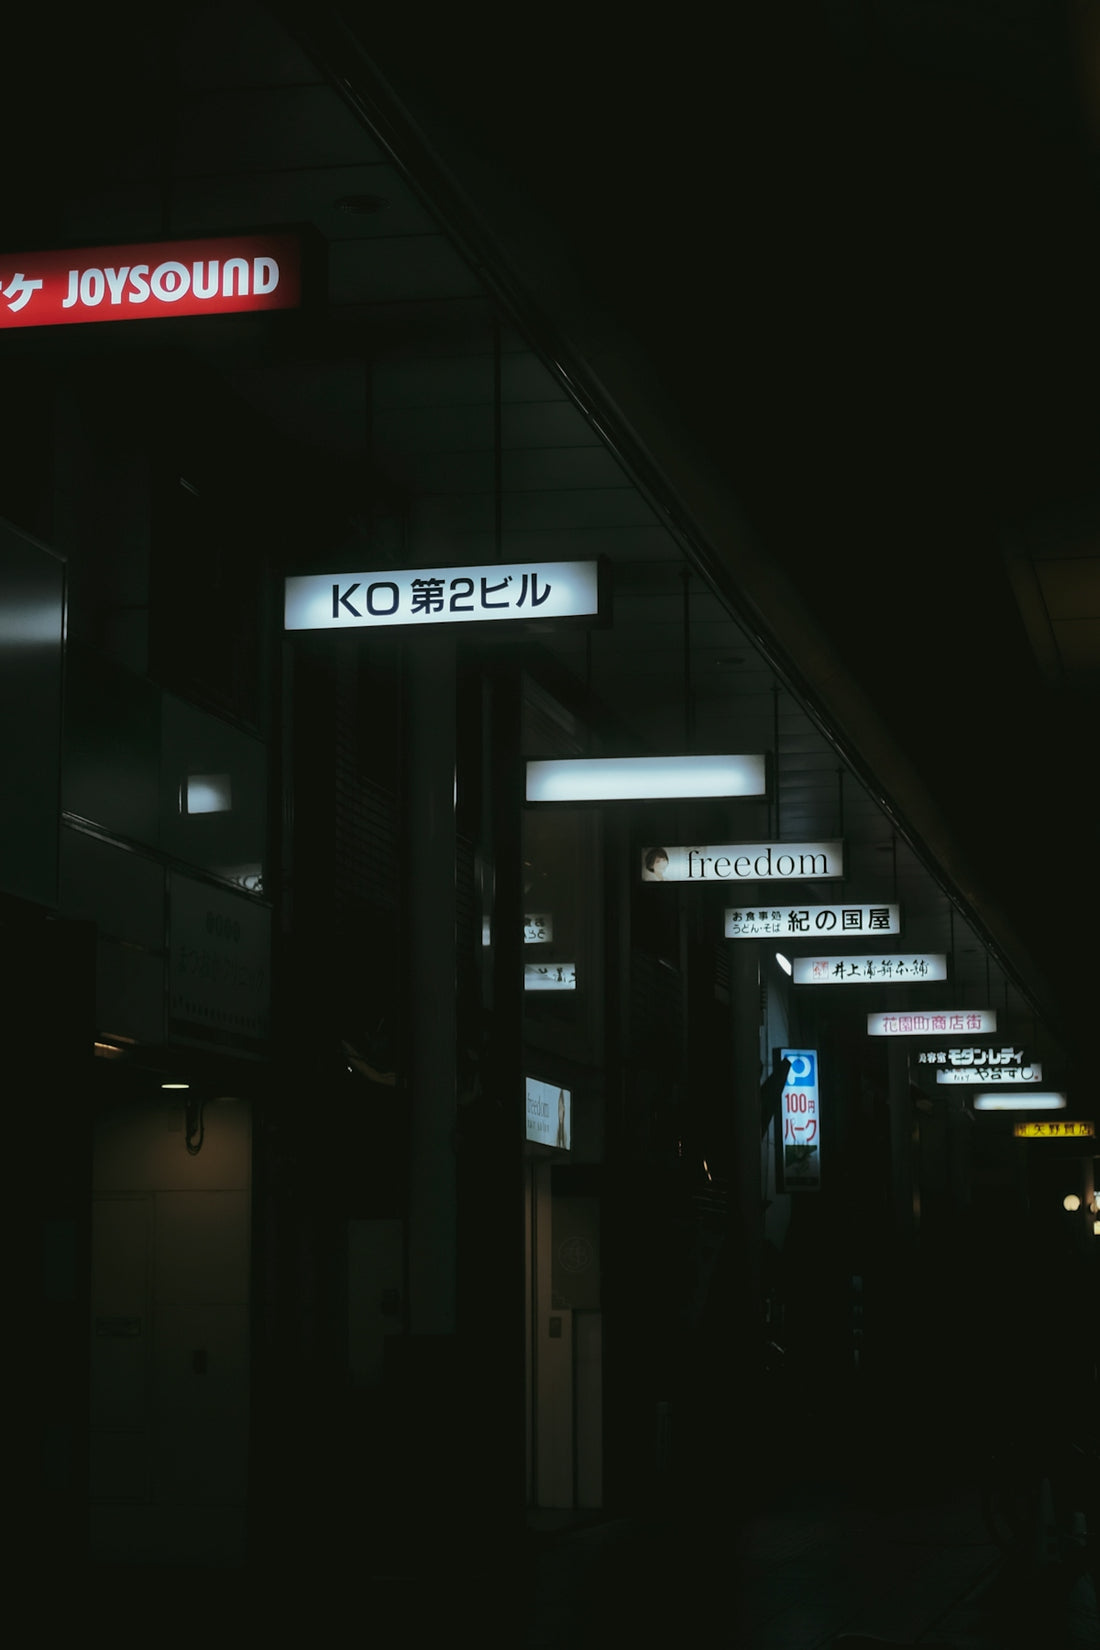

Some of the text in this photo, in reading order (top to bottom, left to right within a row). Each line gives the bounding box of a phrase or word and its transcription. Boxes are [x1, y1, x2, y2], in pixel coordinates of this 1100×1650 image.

[62, 257, 280, 308] JOYSOUND
[332, 573, 552, 619] KO 第2ビル
[687, 848, 830, 878] freedom
[732, 908, 891, 932] お食事処 紀の国屋
[732, 923, 781, 935] うどん・そば
[882, 1013, 982, 1033] 花園町商店街
[785, 1093, 816, 1114] 100円
[784, 1118, 817, 1142] パーク
